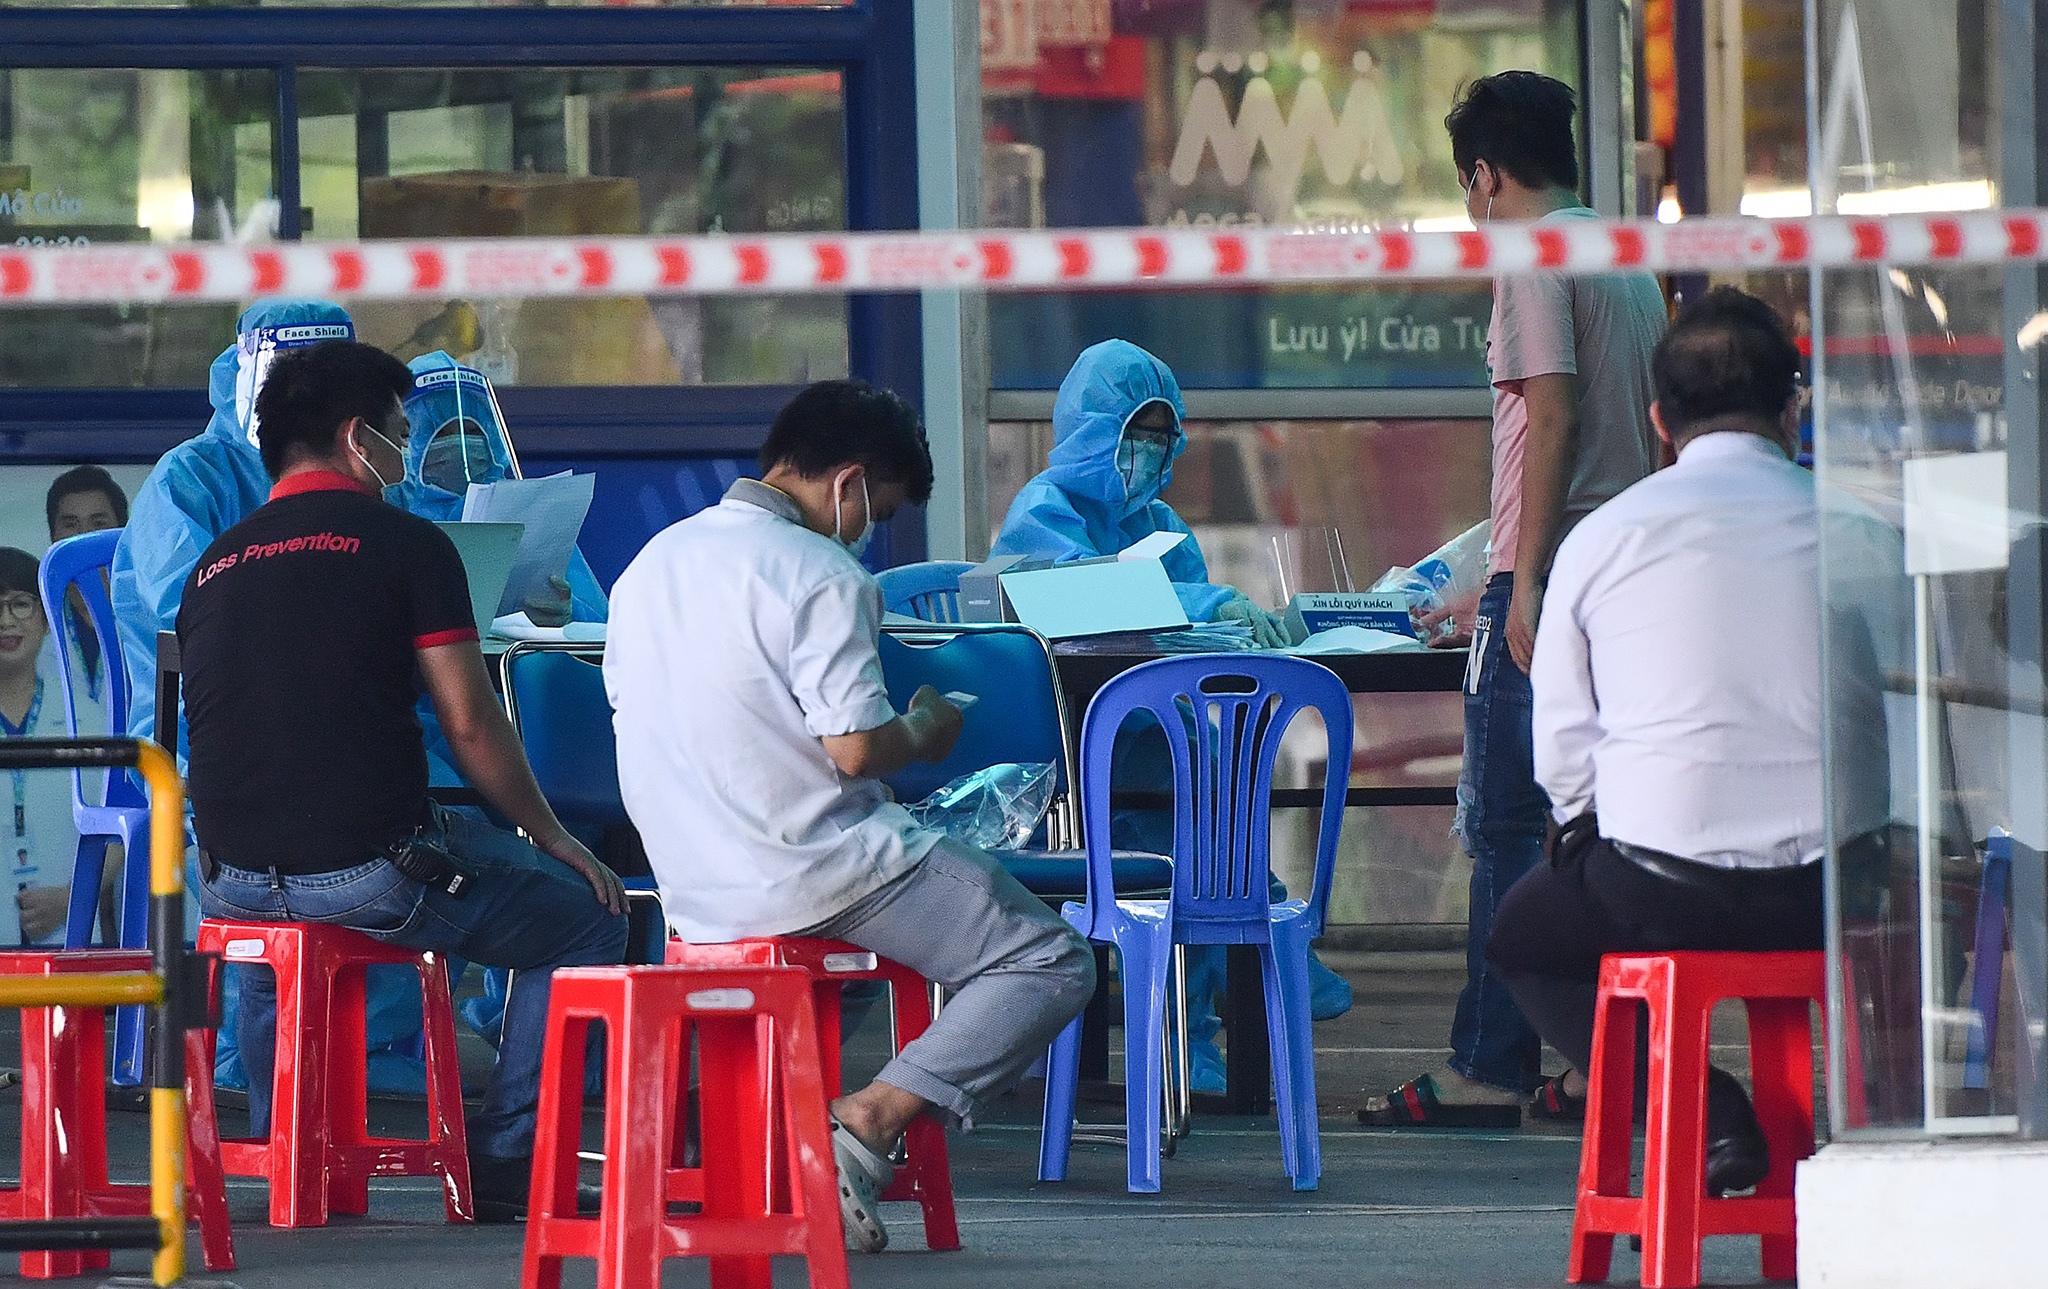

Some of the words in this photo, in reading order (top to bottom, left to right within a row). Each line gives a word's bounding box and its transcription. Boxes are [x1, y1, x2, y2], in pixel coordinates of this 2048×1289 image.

[284, 329, 311, 339] Face
[315, 326, 345, 337] Shield
[1269, 317, 1328, 351] Lưu
[1341, 316, 1368, 362] ý!
[1379, 314, 1441, 351] Cửa
[423, 373, 449, 385] Face
[196, 552, 239, 588] Loss
[241, 531, 361, 564] Prevention
[1312, 599, 1328, 608] XIN
[1344, 598, 1362, 610] QUÝ
[1363, 598, 1393, 609] KHÁCH
